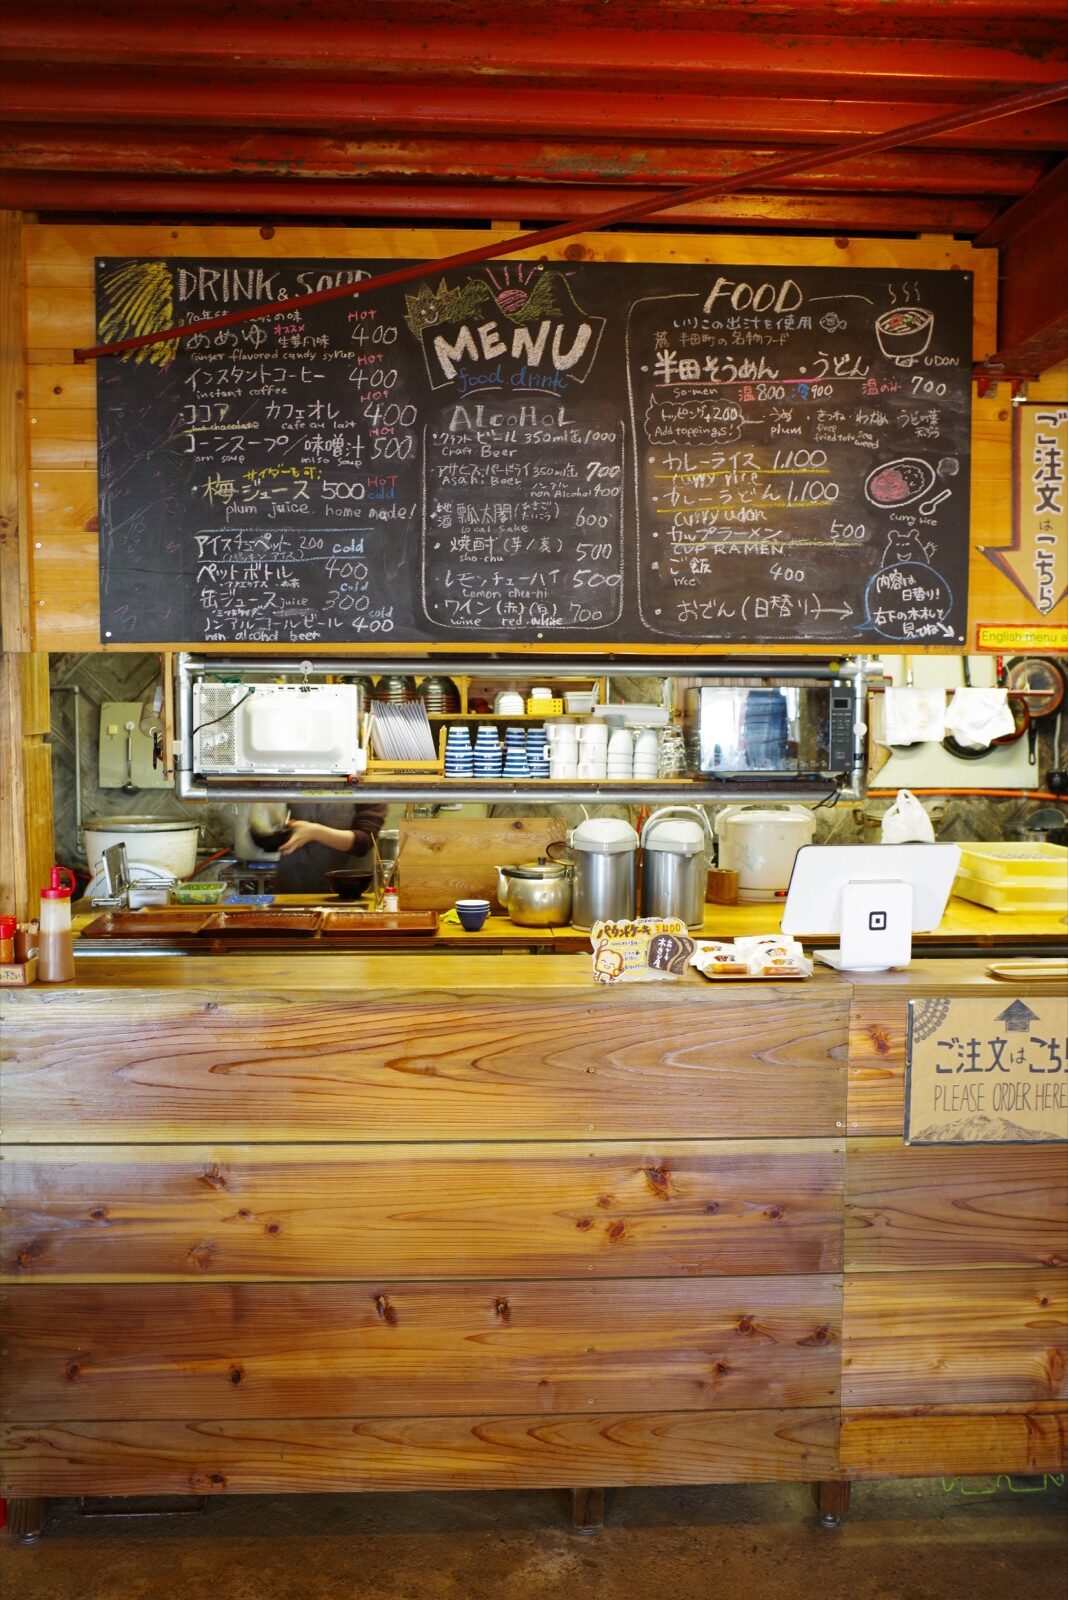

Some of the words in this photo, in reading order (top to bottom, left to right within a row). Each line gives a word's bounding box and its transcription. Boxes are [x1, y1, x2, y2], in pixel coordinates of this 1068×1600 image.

[177, 267, 280, 302] DRINK
[703, 277, 803, 314] FOOD
[348, 310, 377, 323] HOT
[351, 323, 398, 347] 400
[228, 348, 279, 362] flavored
[282, 350, 317, 361] candy
[323, 350, 355, 361] syrup
[357, 354, 384, 366] HOT
[433, 320, 592, 380] MENU
[653, 349, 779, 384] 半田そうめん
[812, 351, 870, 379] うどん
[924, 355, 959, 367] UDON
[184, 364, 326, 391] インスタントコーヒー
[349, 367, 398, 391] 400
[457, 364, 503, 392] food
[511, 366, 569, 388] drink
[196, 387, 242, 399] instant
[249, 385, 288, 396] coffee
[360, 390, 389, 403] HOT
[756, 383, 785, 401] 800
[810, 384, 834, 399] 900
[911, 376, 946, 396] 700
[184, 403, 230, 424] ココア
[265, 399, 340, 420] カフェオレ
[364, 401, 418, 427] 400
[282, 421, 305, 431] cafe
[655, 426, 673, 437] Add
[771, 424, 802, 437] plum
[371, 435, 412, 460] 500
[439, 429, 517, 445] クラフトビール
[584, 430, 617, 444] 1000
[481, 445, 517, 458] Beer
[662, 451, 761, 471] カレーライス
[773, 450, 827, 469] 1,100
[367, 476, 398, 487] HOT
[586, 461, 621, 482] 700
[201, 472, 310, 504] 梅ジュース
[321, 480, 366, 500] 500
[368, 485, 396, 500] cold
[594, 483, 621, 498] 400
[663, 484, 781, 506] カレーうどん
[225, 501, 258, 523] plum
[325, 504, 361, 518] home
[576, 507, 613, 528] 600
[1034, 411, 1068, 612] ご注文はこちら
[461, 526, 490, 534] local
[499, 525, 529, 534] sake
[667, 525, 783, 542] カップラーメン
[830, 519, 866, 540] 500
[299, 536, 324, 550] 200
[332, 538, 366, 553] cold
[576, 542, 613, 562] 500
[714, 544, 783, 555] RAMEN
[196, 562, 294, 583] ペットボトル
[325, 555, 368, 580] 400
[445, 569, 560, 588] レモンチューハイ
[573, 569, 622, 588] 500
[670, 556, 712, 575] ご飯
[770, 562, 804, 581] 400
[200, 587, 280, 609] 缶ジュース
[323, 590, 370, 611] 300
[368, 606, 394, 618] cold
[570, 601, 603, 623] 700
[204, 613, 344, 632] ノンアルコールビール
[352, 616, 394, 633] 400
[982, 630, 1022, 643] English
[1026, 633, 1057, 642] menu
[935, 1036, 1068, 1074] ご注文はこち
[934, 1083, 985, 1112] PLEASE
[993, 1082, 1031, 1112] ORDER
[1035, 1082, 1068, 1112] HERE
